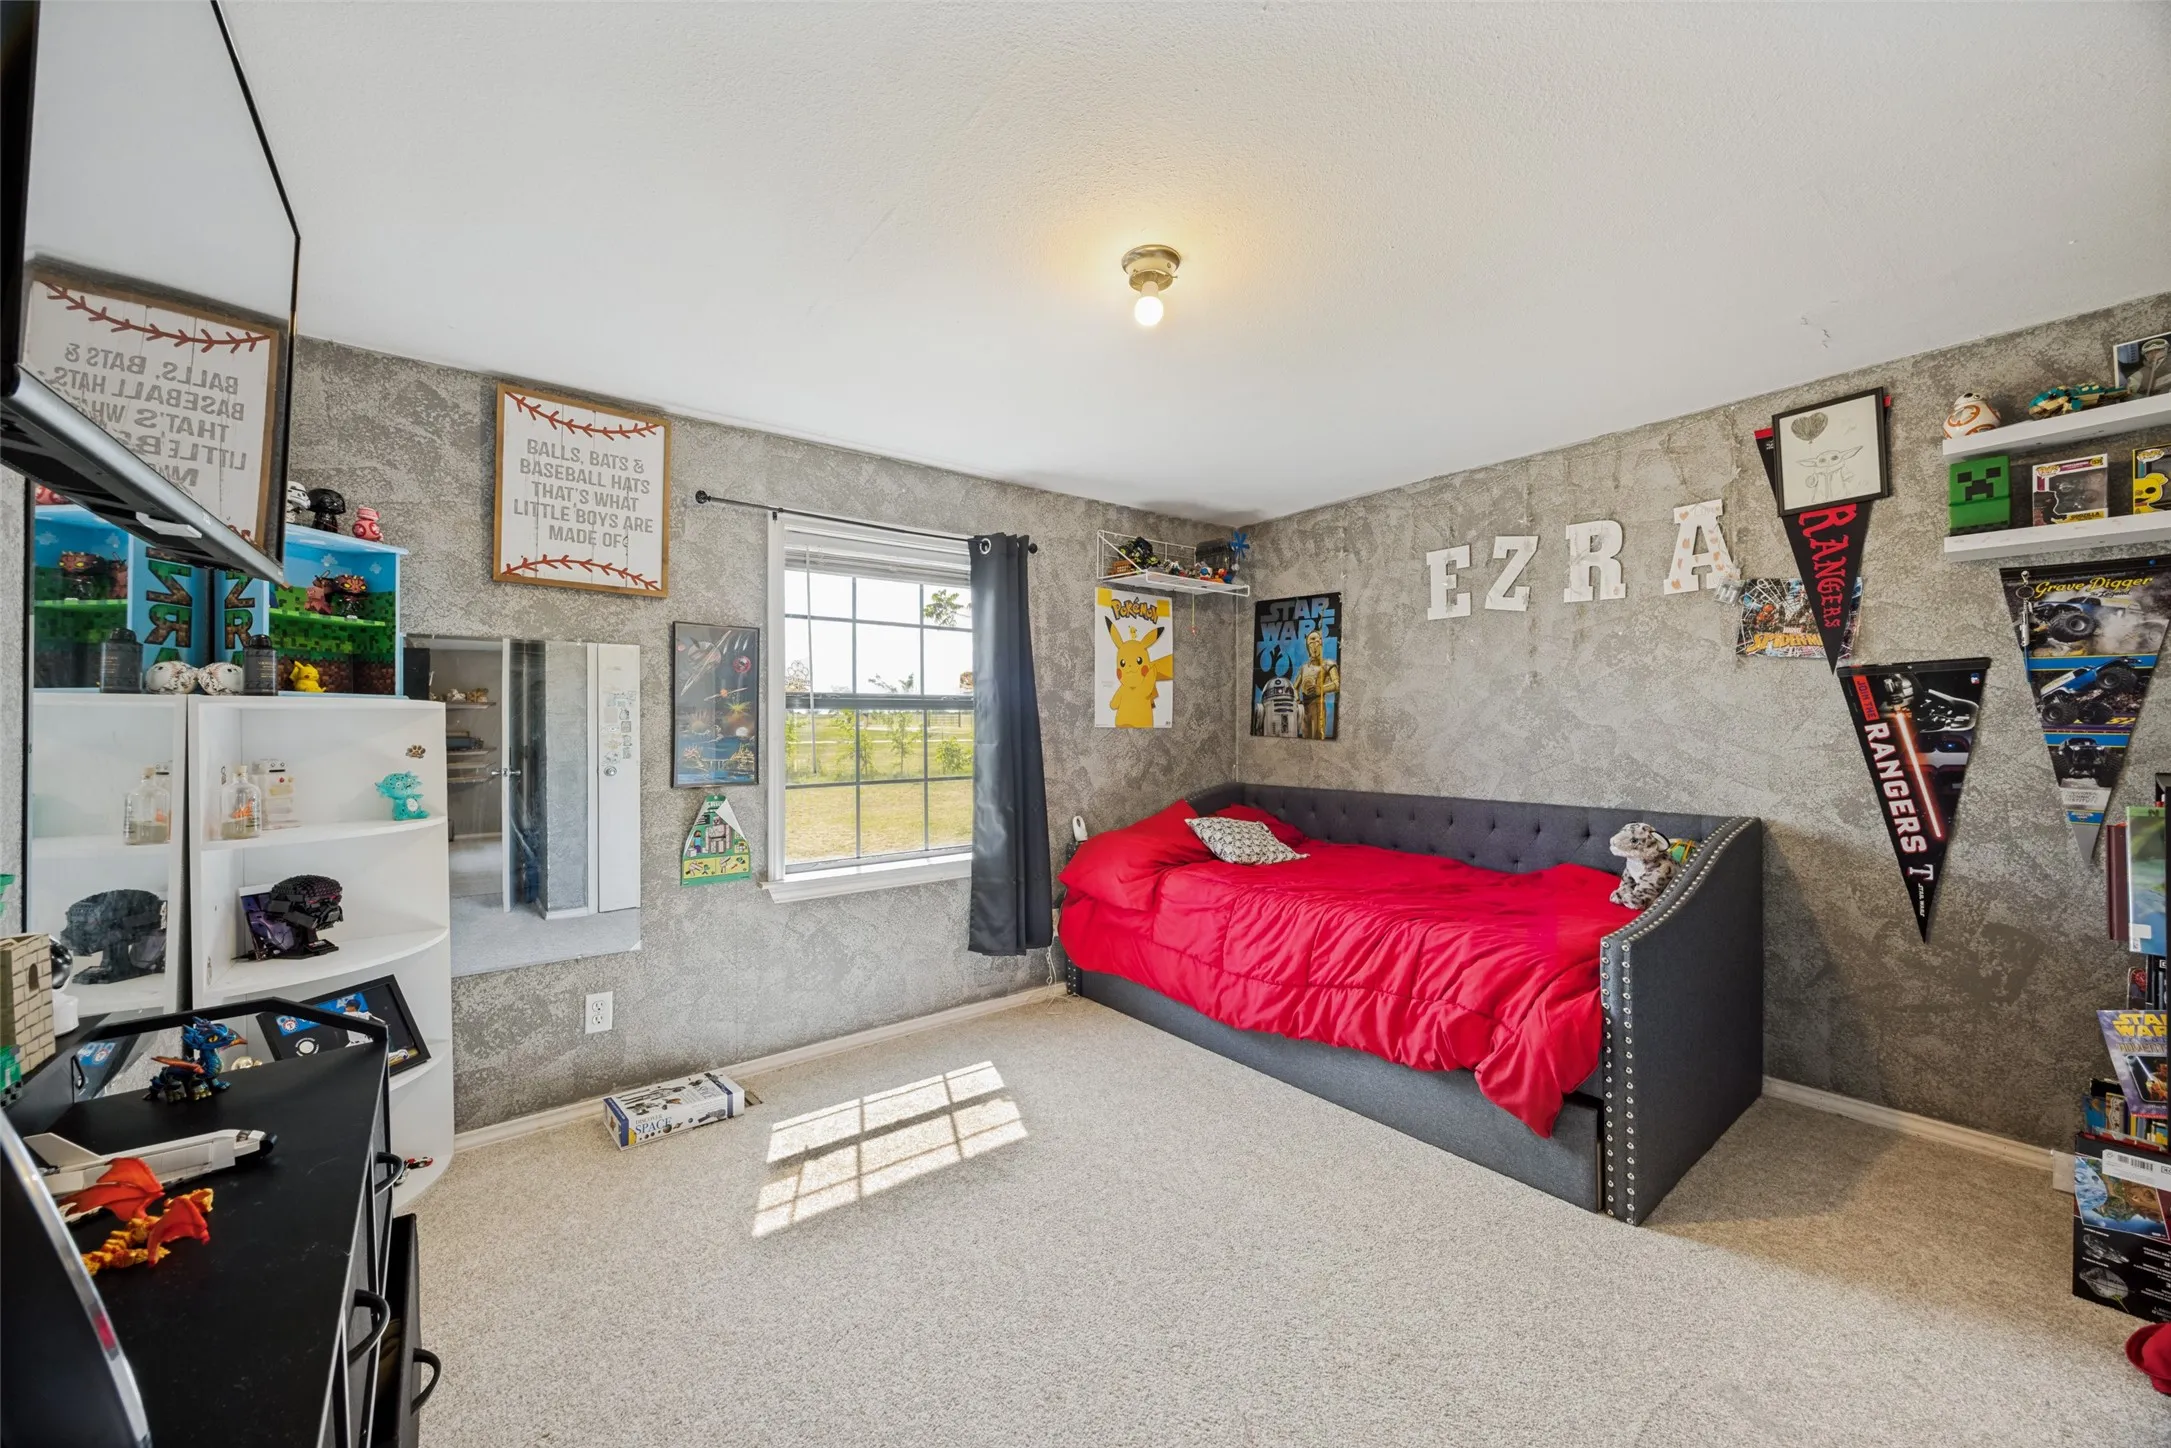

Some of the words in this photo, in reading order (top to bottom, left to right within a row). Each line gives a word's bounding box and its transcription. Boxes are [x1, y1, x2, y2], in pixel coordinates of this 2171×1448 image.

[527, 438, 584, 465] BALLS,
[589, 450, 629, 472] BATS
[632, 458, 645, 474] &
[519, 457, 607, 489] BASEBALL
[610, 474, 651, 495] HATS
[531, 480, 590, 505] THAT'S
[594, 491, 640, 513] WHAT
[513, 498, 570, 523] LITTLE
[575, 507, 619, 529] BOYS
[622, 515, 654, 534] ARE
[548, 524, 597, 547] MADE
[601, 532, 623, 549] OF
[1798, 503, 1857, 628] RANGERS
[2034, 580, 2085, 599] Grave
[2085, 575, 2154, 593] Digger
[2098, 590, 2130, 599] Legend
[1260, 597, 1336, 622] STAR
[1260, 617, 1337, 642] WARS
[1856, 680, 1869, 700] JOIN
[1864, 702, 1877, 718] THE
[1864, 722, 1928, 853] RANGERS
[1906, 863, 1934, 881] T
[635, 1116, 673, 1134] SPACE
